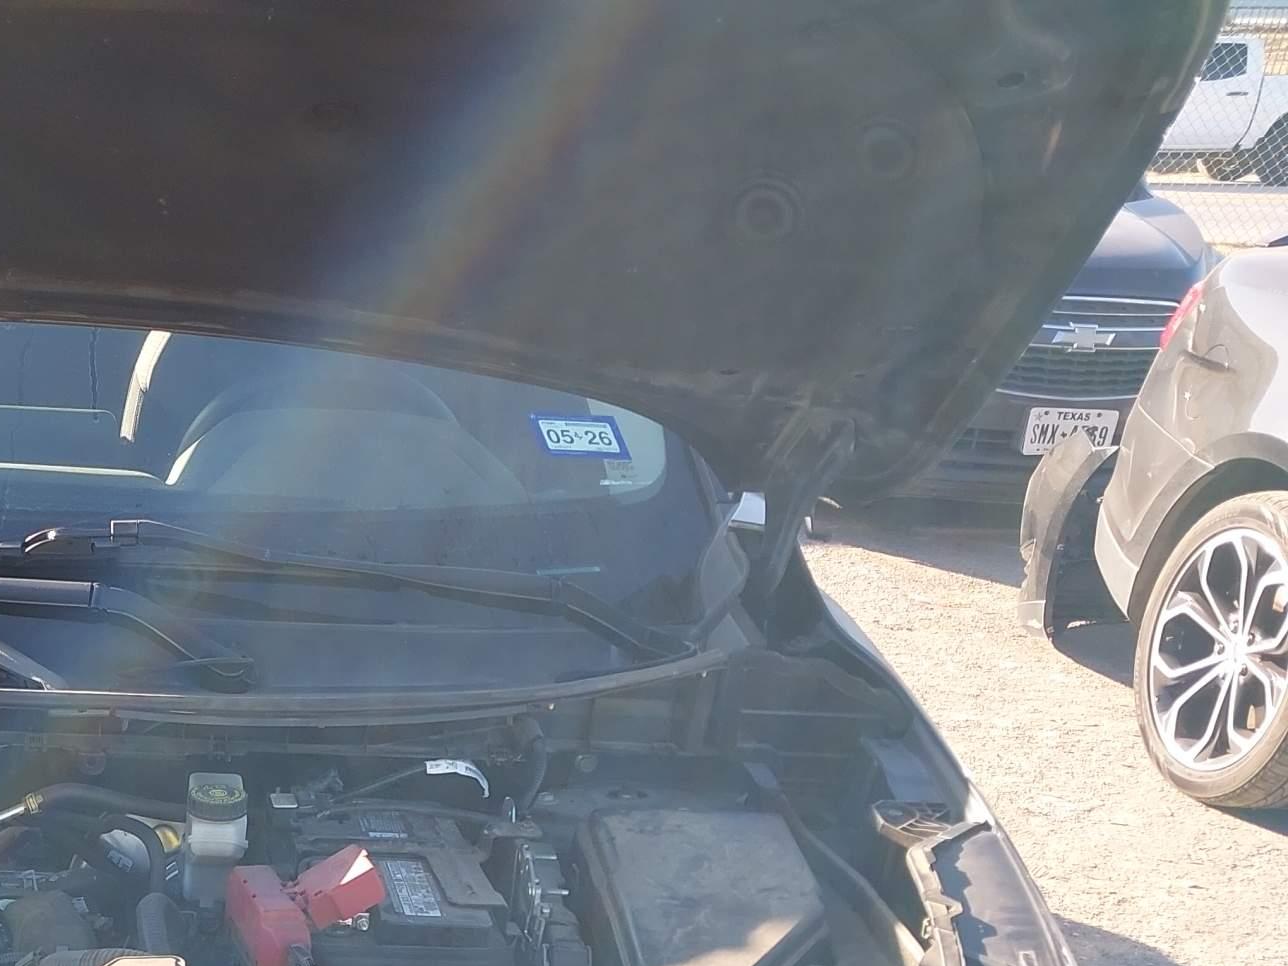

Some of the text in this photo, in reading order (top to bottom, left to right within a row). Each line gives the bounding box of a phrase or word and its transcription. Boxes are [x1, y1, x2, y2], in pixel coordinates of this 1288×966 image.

[1056, 411, 1091, 422] TEXAS
[546, 428, 613, 447] 05 26
[1030, 423, 1059, 444] SMX
